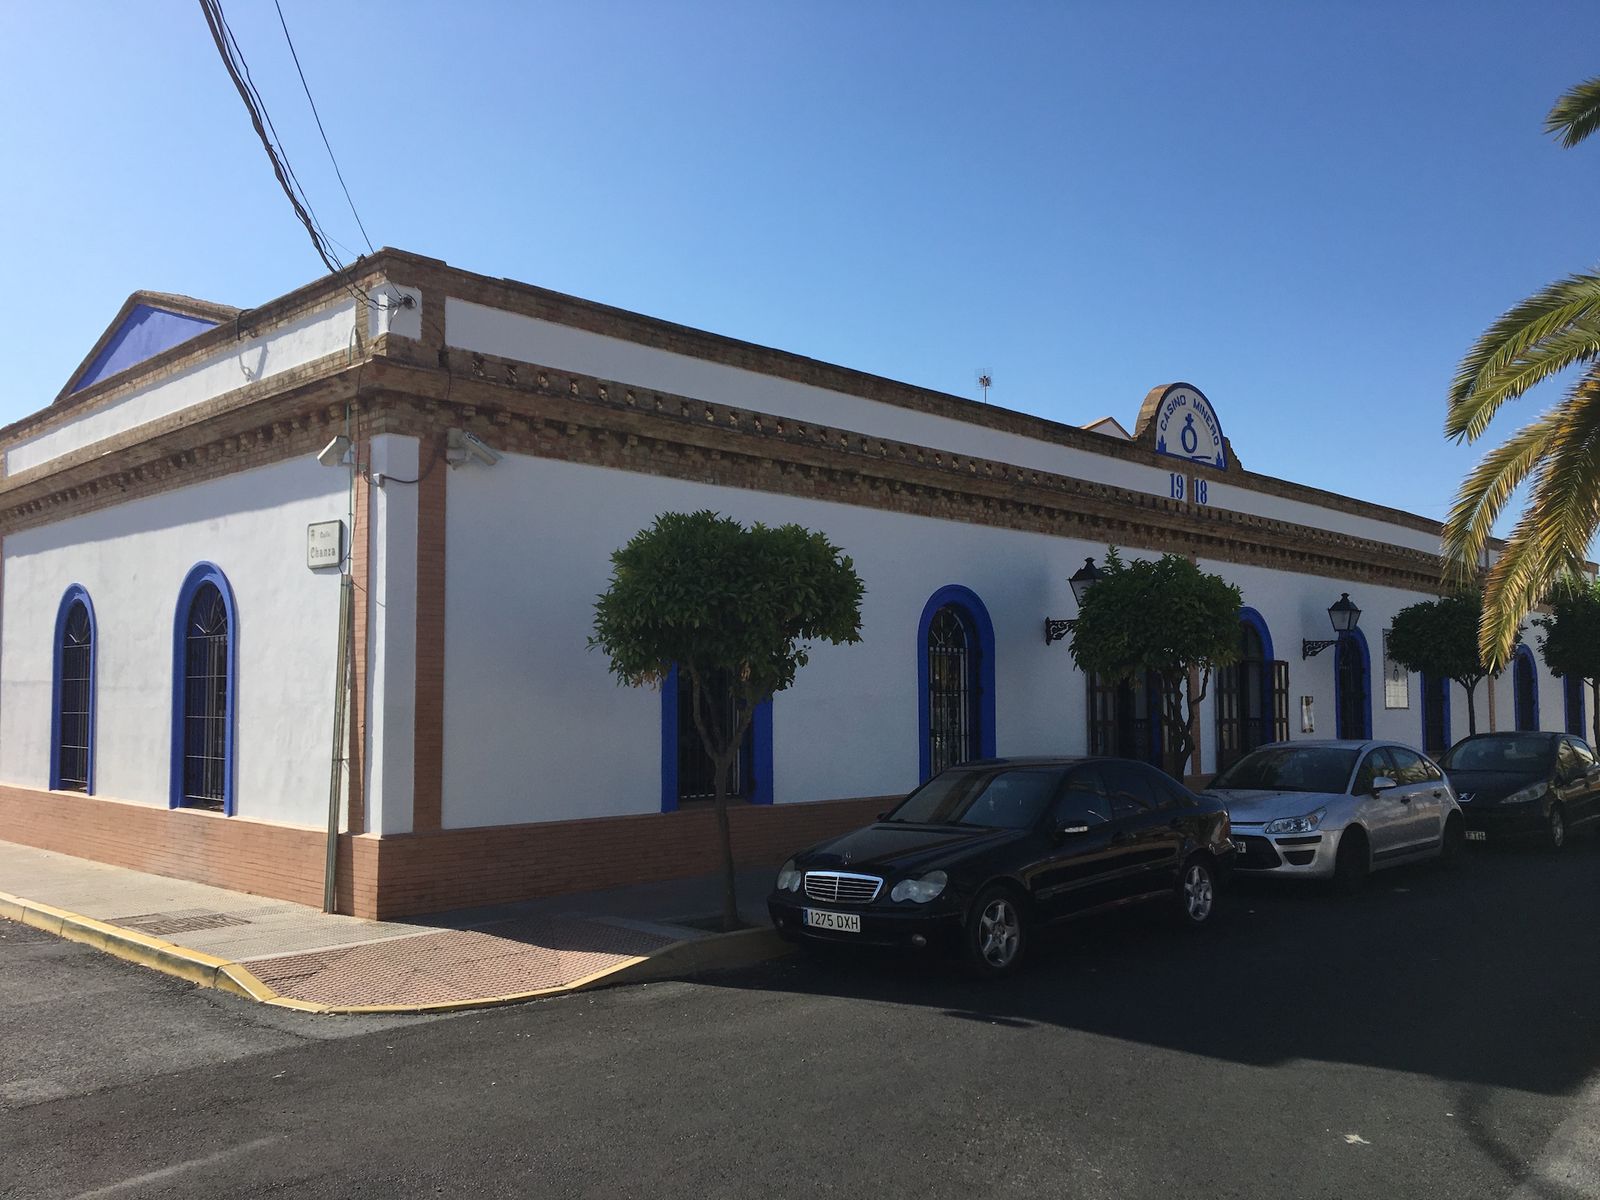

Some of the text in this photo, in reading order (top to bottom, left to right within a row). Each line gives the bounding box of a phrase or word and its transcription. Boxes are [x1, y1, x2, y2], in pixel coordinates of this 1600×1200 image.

[1160, 394, 1220, 446] CASINO MINERO
[1169, 473, 1208, 505] 19 18
[810, 911, 859, 930] 1275 DXH
